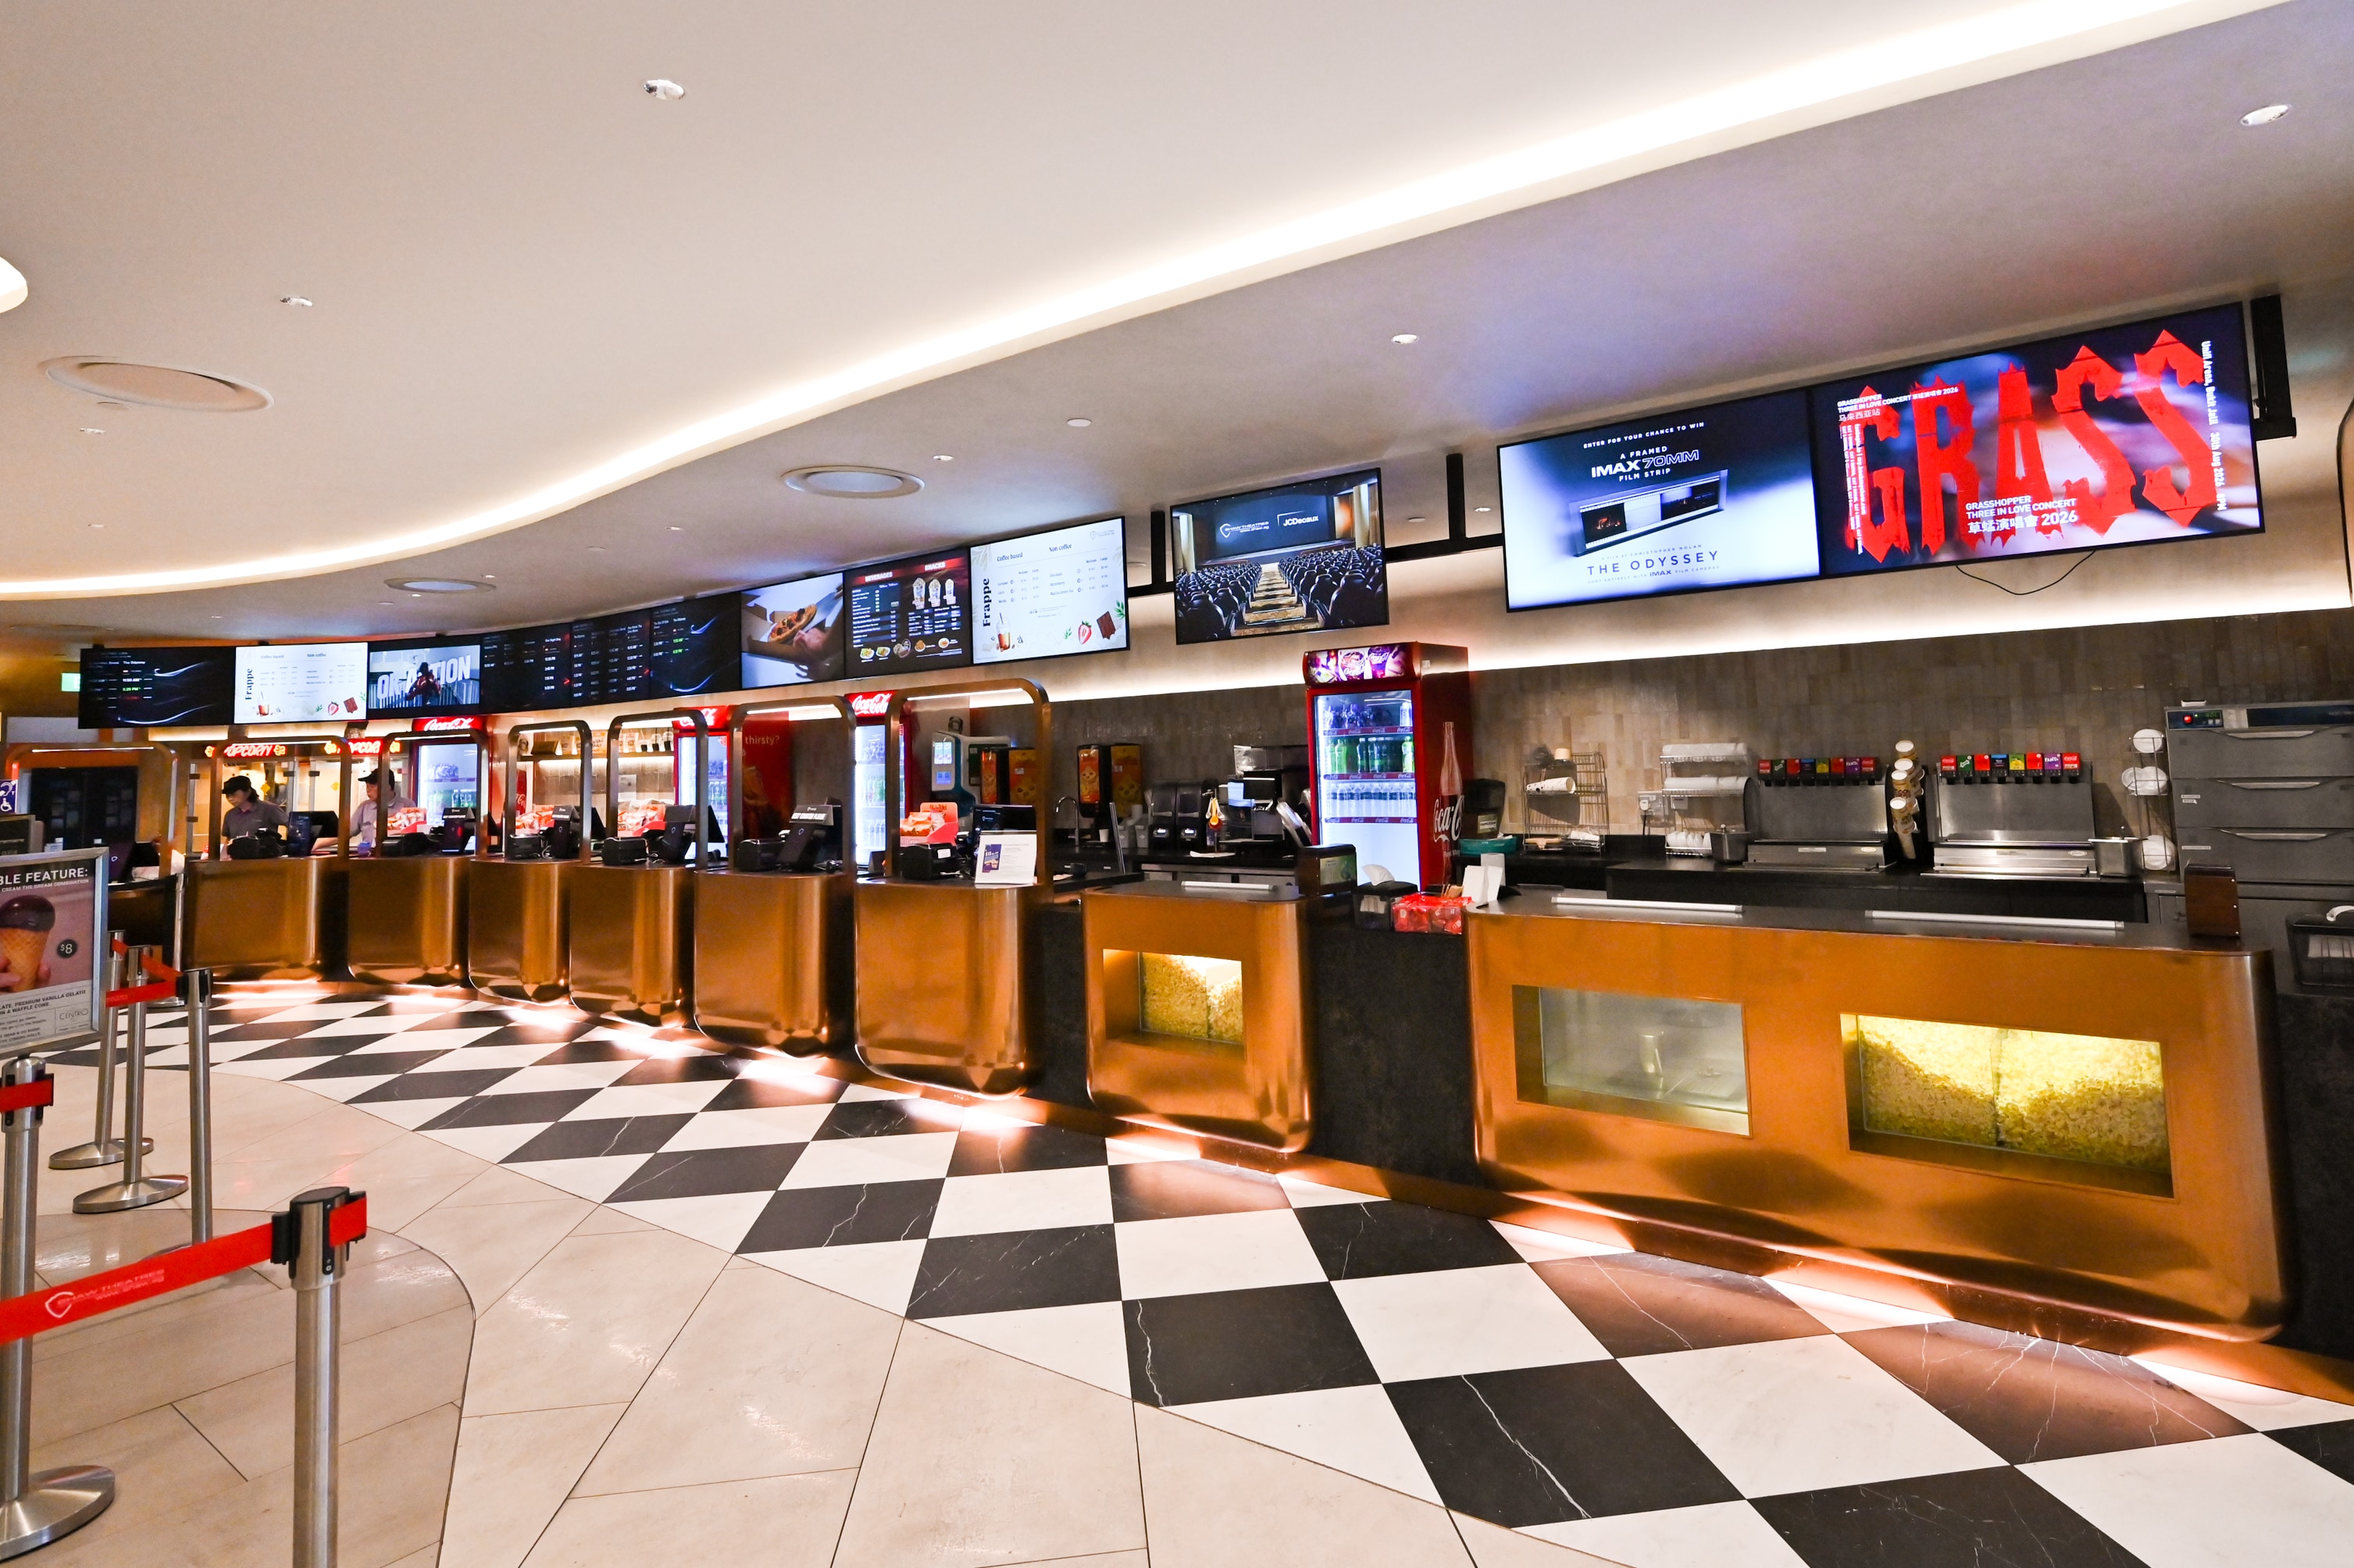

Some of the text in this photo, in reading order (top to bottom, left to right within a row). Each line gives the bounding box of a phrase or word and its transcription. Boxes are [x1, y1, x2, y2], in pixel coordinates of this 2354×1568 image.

[1837, 394, 1882, 407] GRASSHOPPER
[1838, 404, 1858, 414] THREE
[1882, 394, 1912, 405] CONCERT
[1839, 408, 1881, 422] 马来西亚站
[2201, 340, 2227, 511] Unifi Arena, Bukit Jalil 30th Aug 2026 8PM
[1624, 433, 1642, 442] YOUR
[1645, 427, 1675, 437] CHANCE
[1630, 446, 1667, 458] FRAMED
[1839, 329, 2218, 564] GRASS
[1591, 449, 1700, 478] IMAX 70MM
[1618, 468, 1671, 482] FILM STRIP
[1965, 495, 2031, 511] GRASSHOPPER
[1966, 509, 1996, 519] THREE
[2009, 504, 2031, 514] LOVE
[2032, 498, 2077, 511] CONCERT
[1282, 515, 1319, 526] JCDecaux
[1968, 510, 2078, 534] 草蜢演唱會 2026
[1630, 547, 1676, 557] CHRISTOPHER
[925, 561, 946, 572] SNACKS
[1587, 550, 1718, 576] THE ODYSSEY
[865, 572, 893, 583] BEVERAGES
[983, 578, 992, 627] Frappe
[405, 654, 471, 693] ATION
[245, 668, 255, 700] Frappe
[745, 736, 780, 747] thirsty?
[25, 867, 88, 883] FEATURE:
[60, 943, 73, 954] $8
[14, 998, 41, 1007] PREMIUM
[42, 993, 64, 1002] VANILLA
[59, 1009, 89, 1020] CENTRO
[102, 1269, 164, 1292] THEATRES
